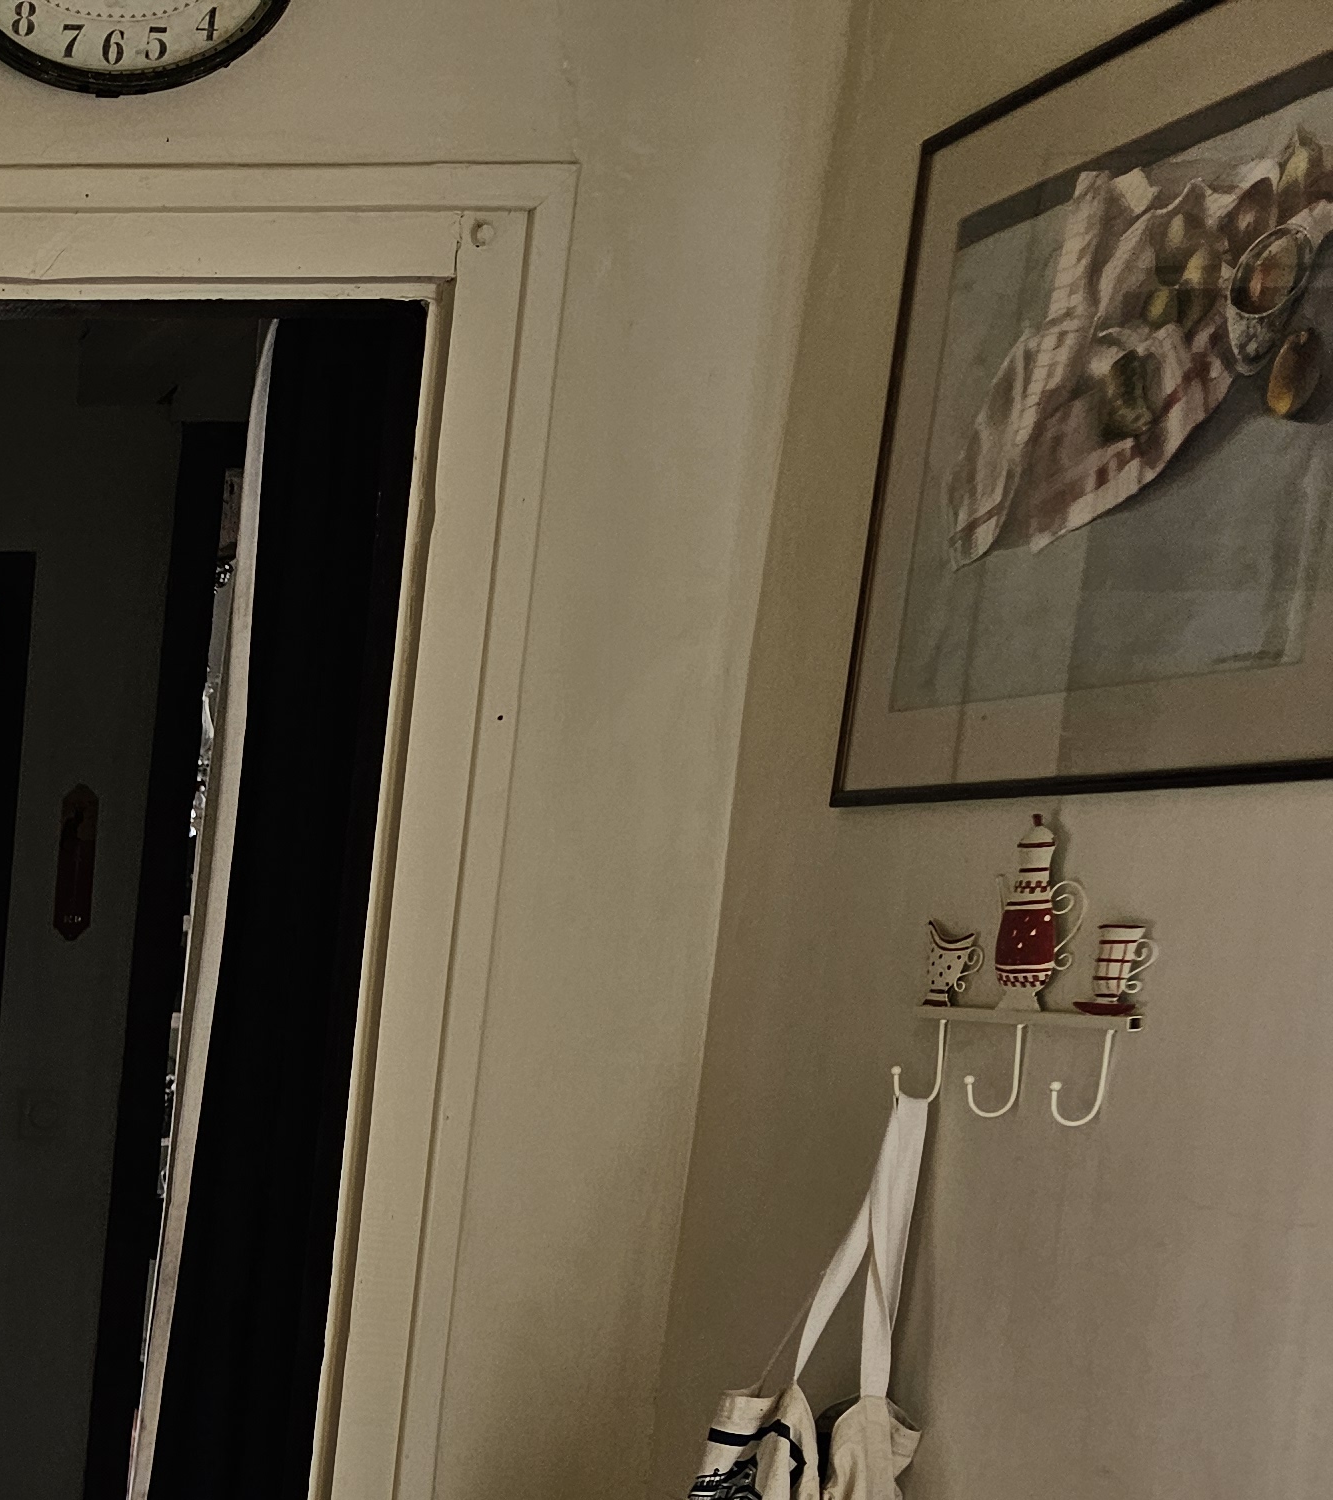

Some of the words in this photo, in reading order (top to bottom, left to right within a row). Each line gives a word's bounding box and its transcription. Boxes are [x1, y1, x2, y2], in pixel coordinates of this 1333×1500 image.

[11, 1, 36, 37] 8
[61, 24, 85, 58] 7
[102, 29, 124, 65] 6
[144, 26, 168, 61] 5
[195, 6, 219, 42] 4
